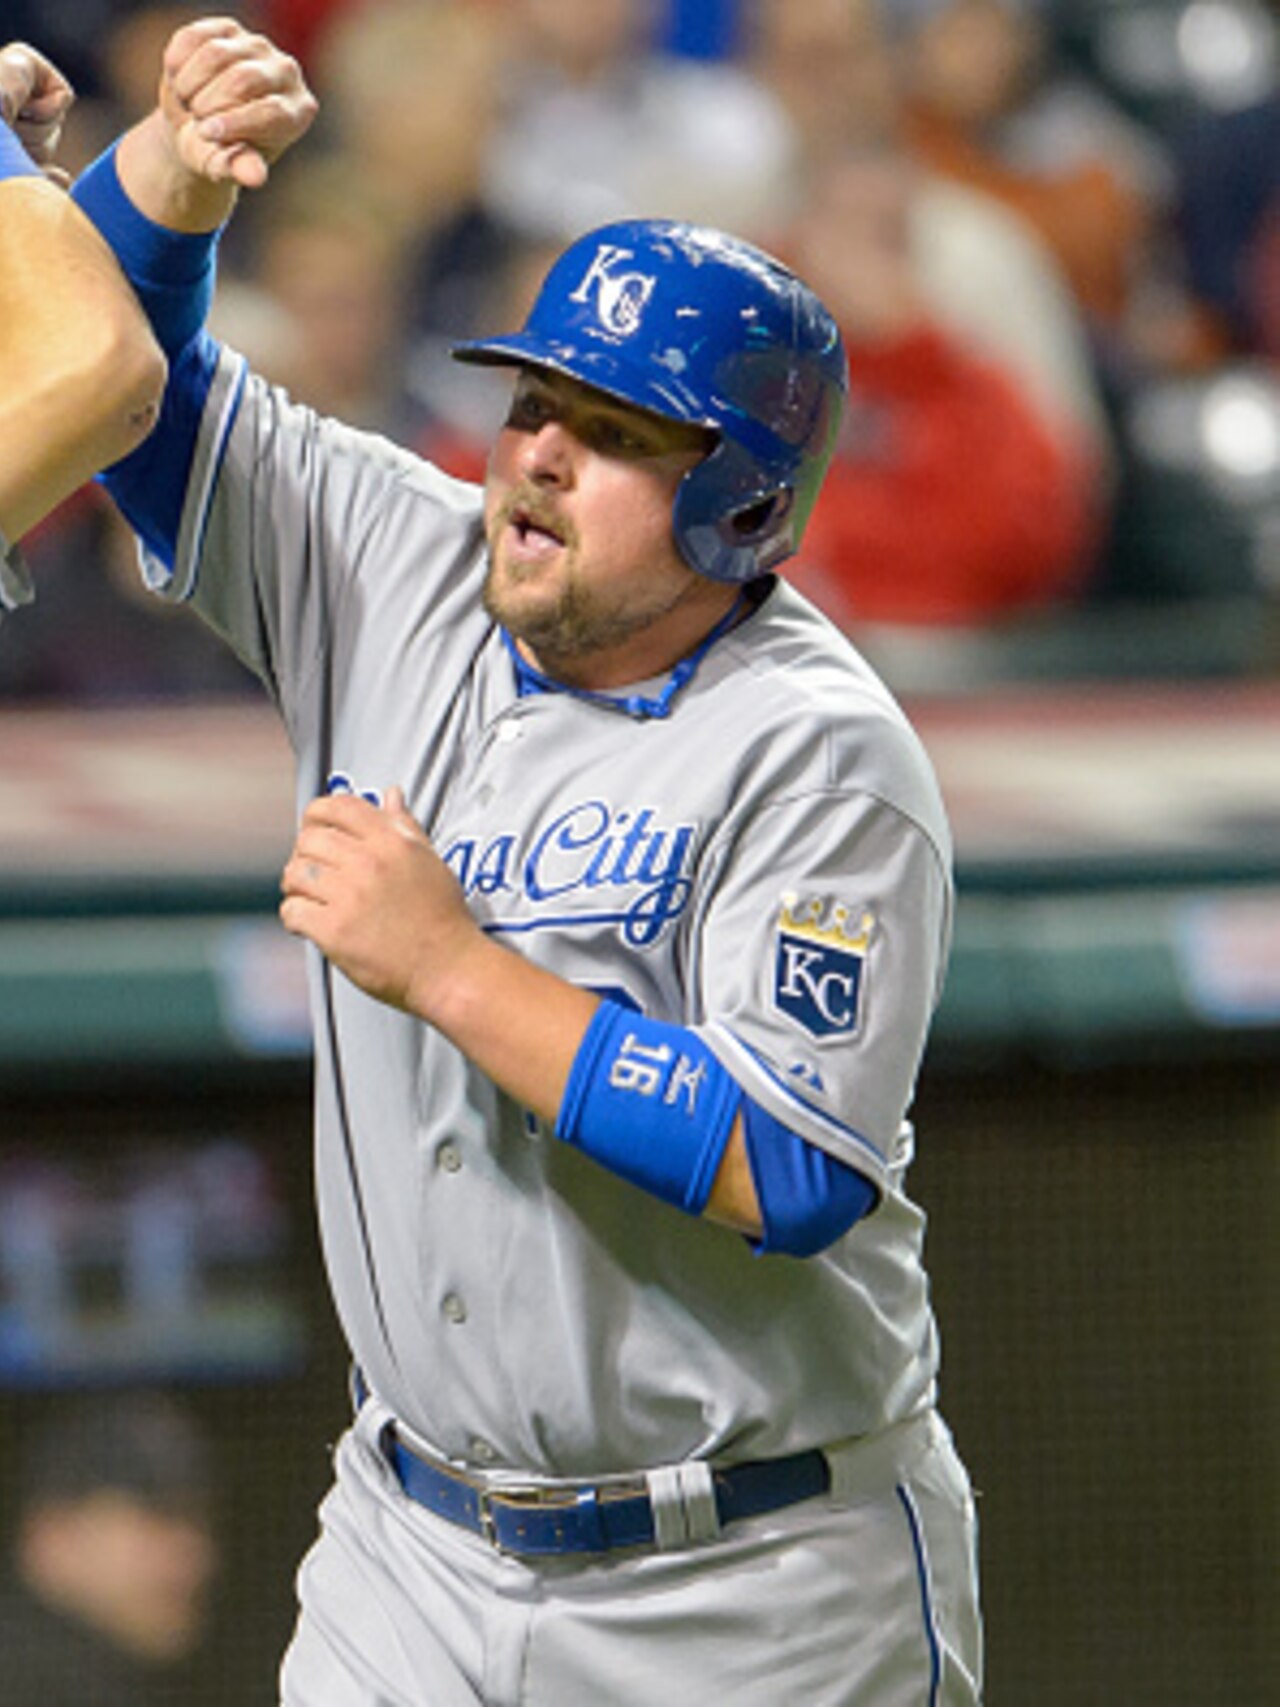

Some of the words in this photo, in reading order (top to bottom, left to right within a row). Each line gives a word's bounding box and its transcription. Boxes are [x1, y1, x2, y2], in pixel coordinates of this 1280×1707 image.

[568, 244, 657, 335] KC
[524, 801, 695, 945] City
[779, 943, 853, 1027] KC
[609, 1033, 672, 1096] 16
